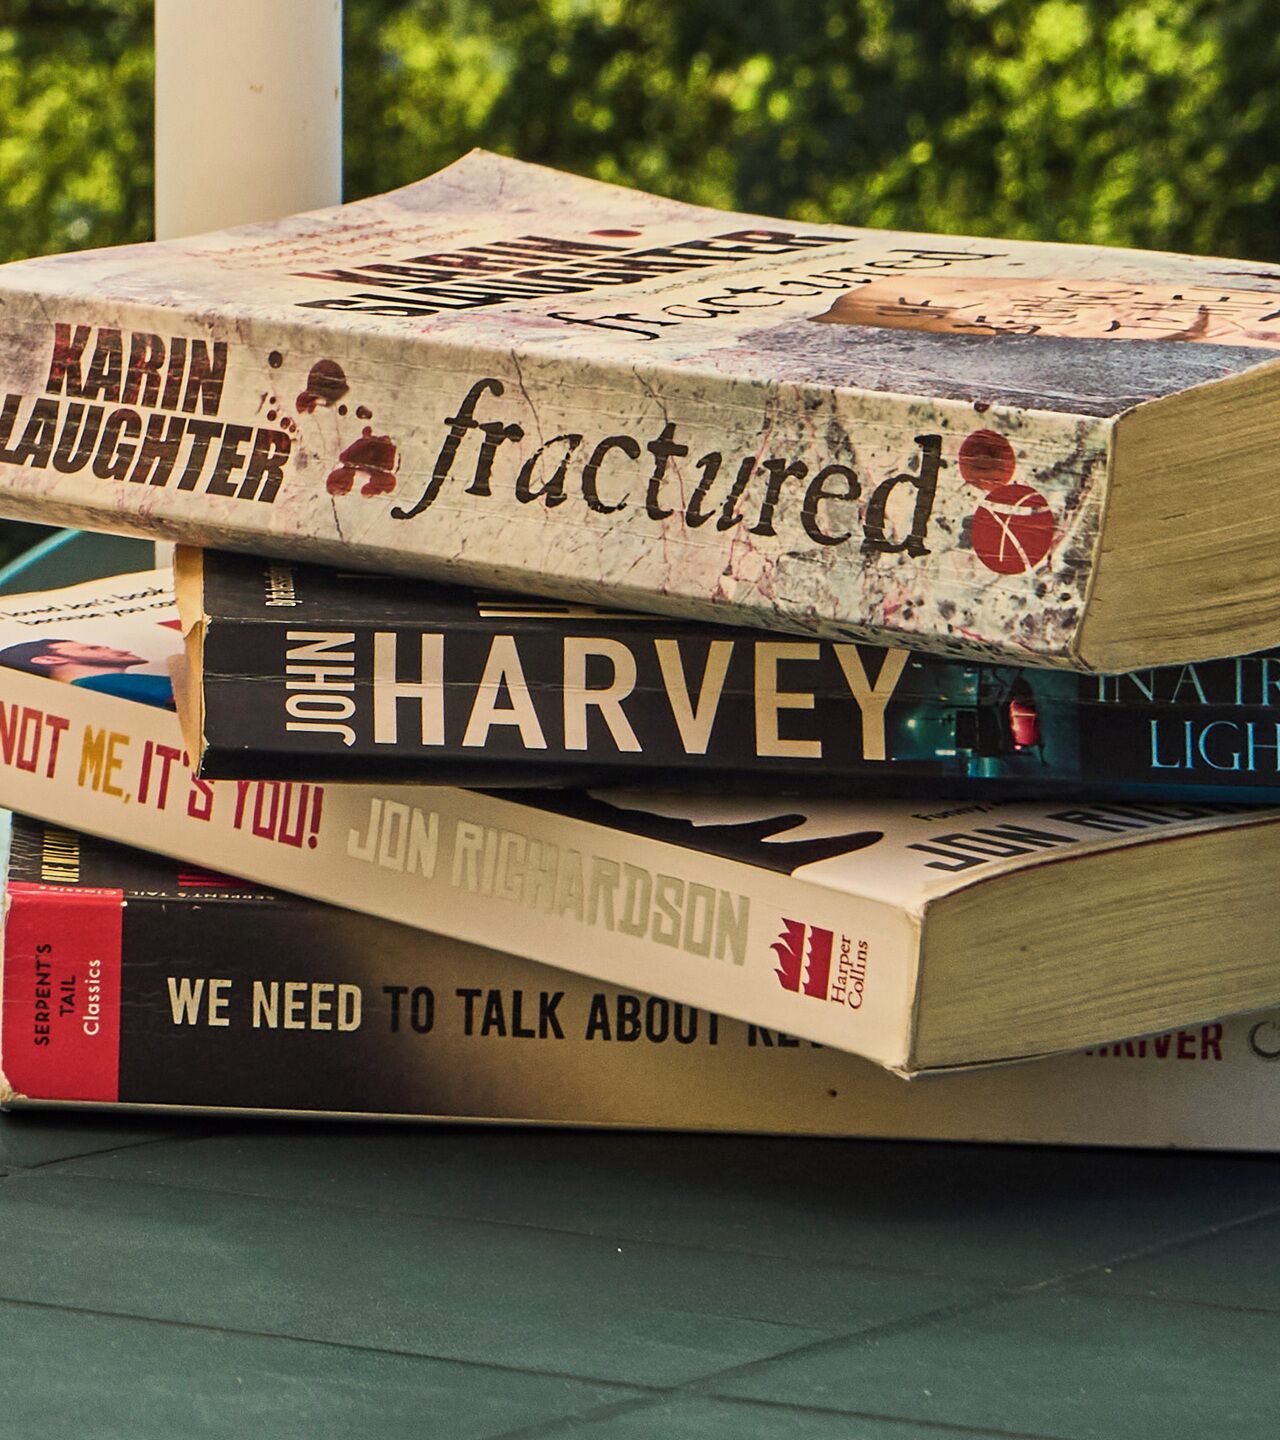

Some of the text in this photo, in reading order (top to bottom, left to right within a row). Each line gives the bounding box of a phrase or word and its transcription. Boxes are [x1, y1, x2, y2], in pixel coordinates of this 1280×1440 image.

[545, 248, 1009, 341] fractured
[45, 322, 228, 417] KARIN
[389, 378, 942, 558] fractured
[285, 631, 913, 762] JOHN HARVEY
[1170, 664, 1209, 704] A
[77, 724, 131, 805] ME,
[136, 740, 216, 822] IT'S
[232, 779, 325, 850] YOU!
[347, 797, 750, 967] JON RICHARDSON
[906, 823, 1081, 874] JON
[33, 941, 53, 1046] SERPENT'S
[59, 974, 77, 1019] TAIL
[82, 957, 102, 1037] Classics
[167, 976, 230, 1027] WE
[251, 982, 362, 1032] NEED
[383, 985, 435, 1036] TO
[456, 987, 565, 1040] TALK
[830, 934, 853, 1006] Harper
[846, 938, 870, 1011] Collins
